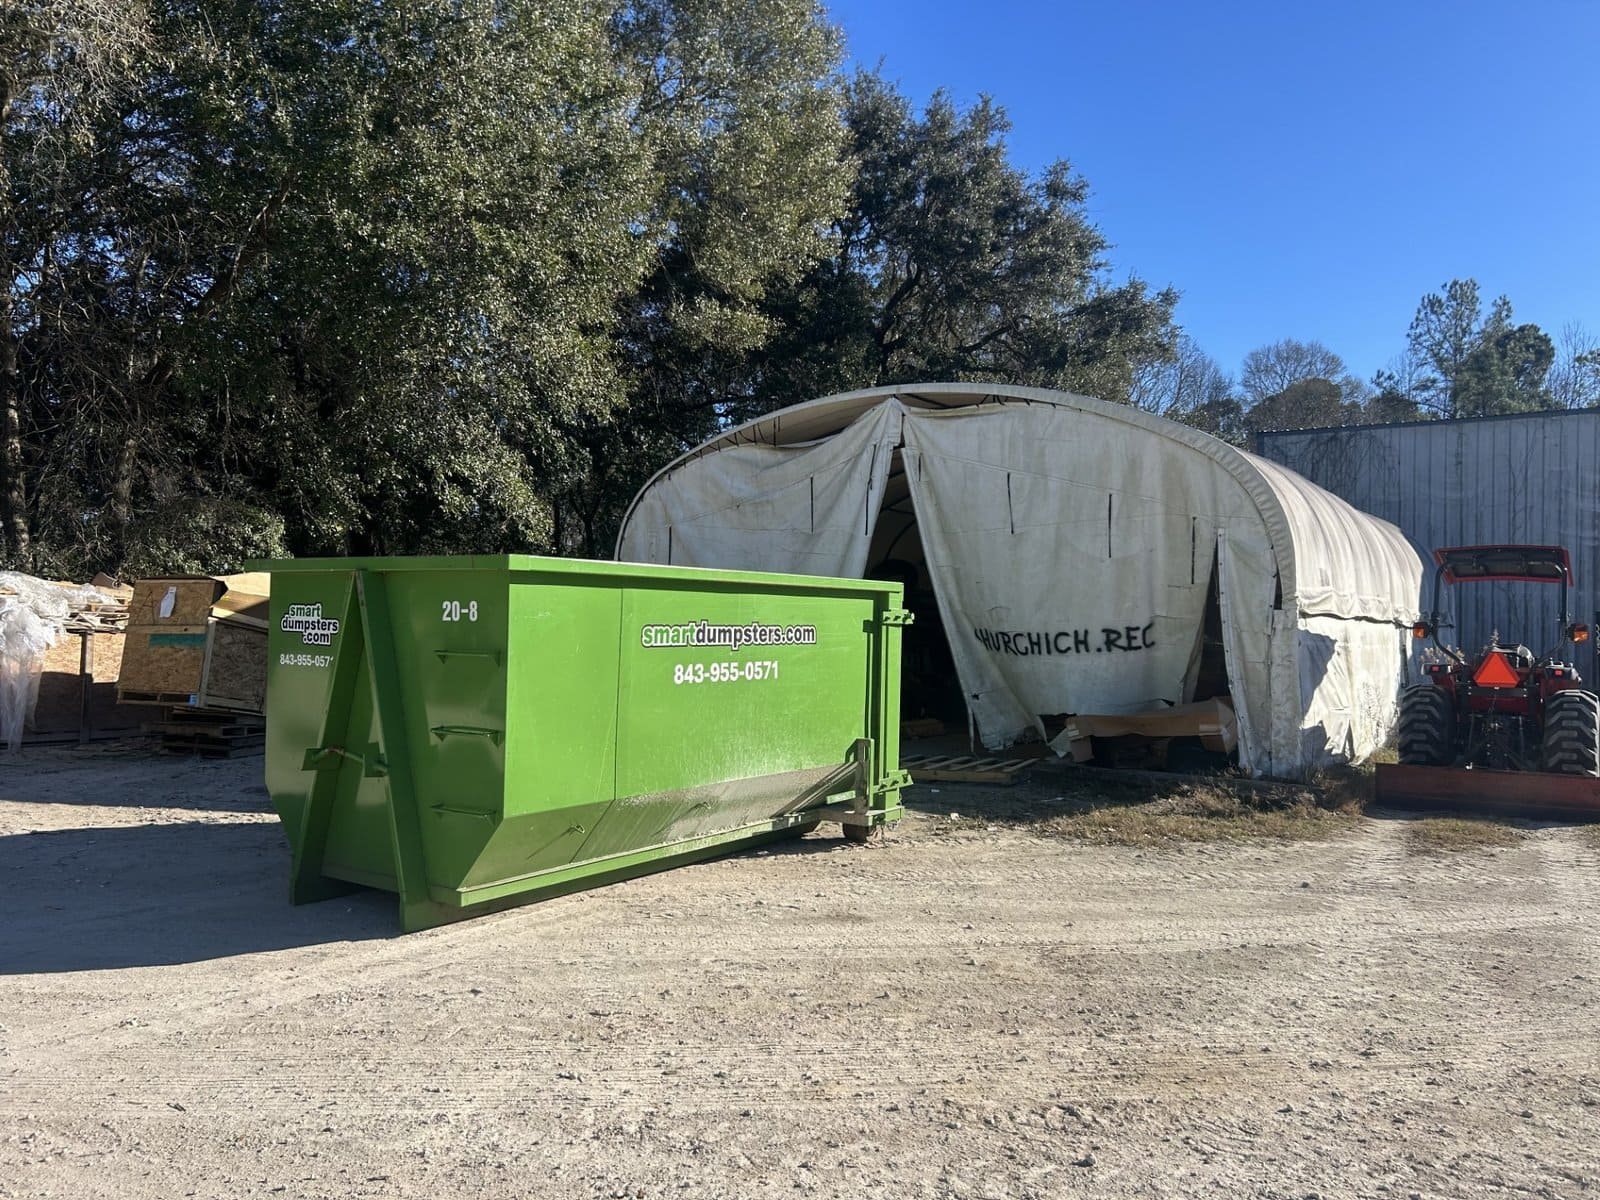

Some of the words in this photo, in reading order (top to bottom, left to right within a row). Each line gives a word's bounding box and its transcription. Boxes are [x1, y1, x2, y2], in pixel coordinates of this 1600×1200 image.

[289, 603, 322, 618] smart
[442, 600, 478, 622] 20-8
[281, 615, 339, 633] dumpsters
[303, 632, 331, 645] .com
[642, 620, 816, 650] smartdumpsters.com
[673, 661, 779, 685] 843-955-0571
